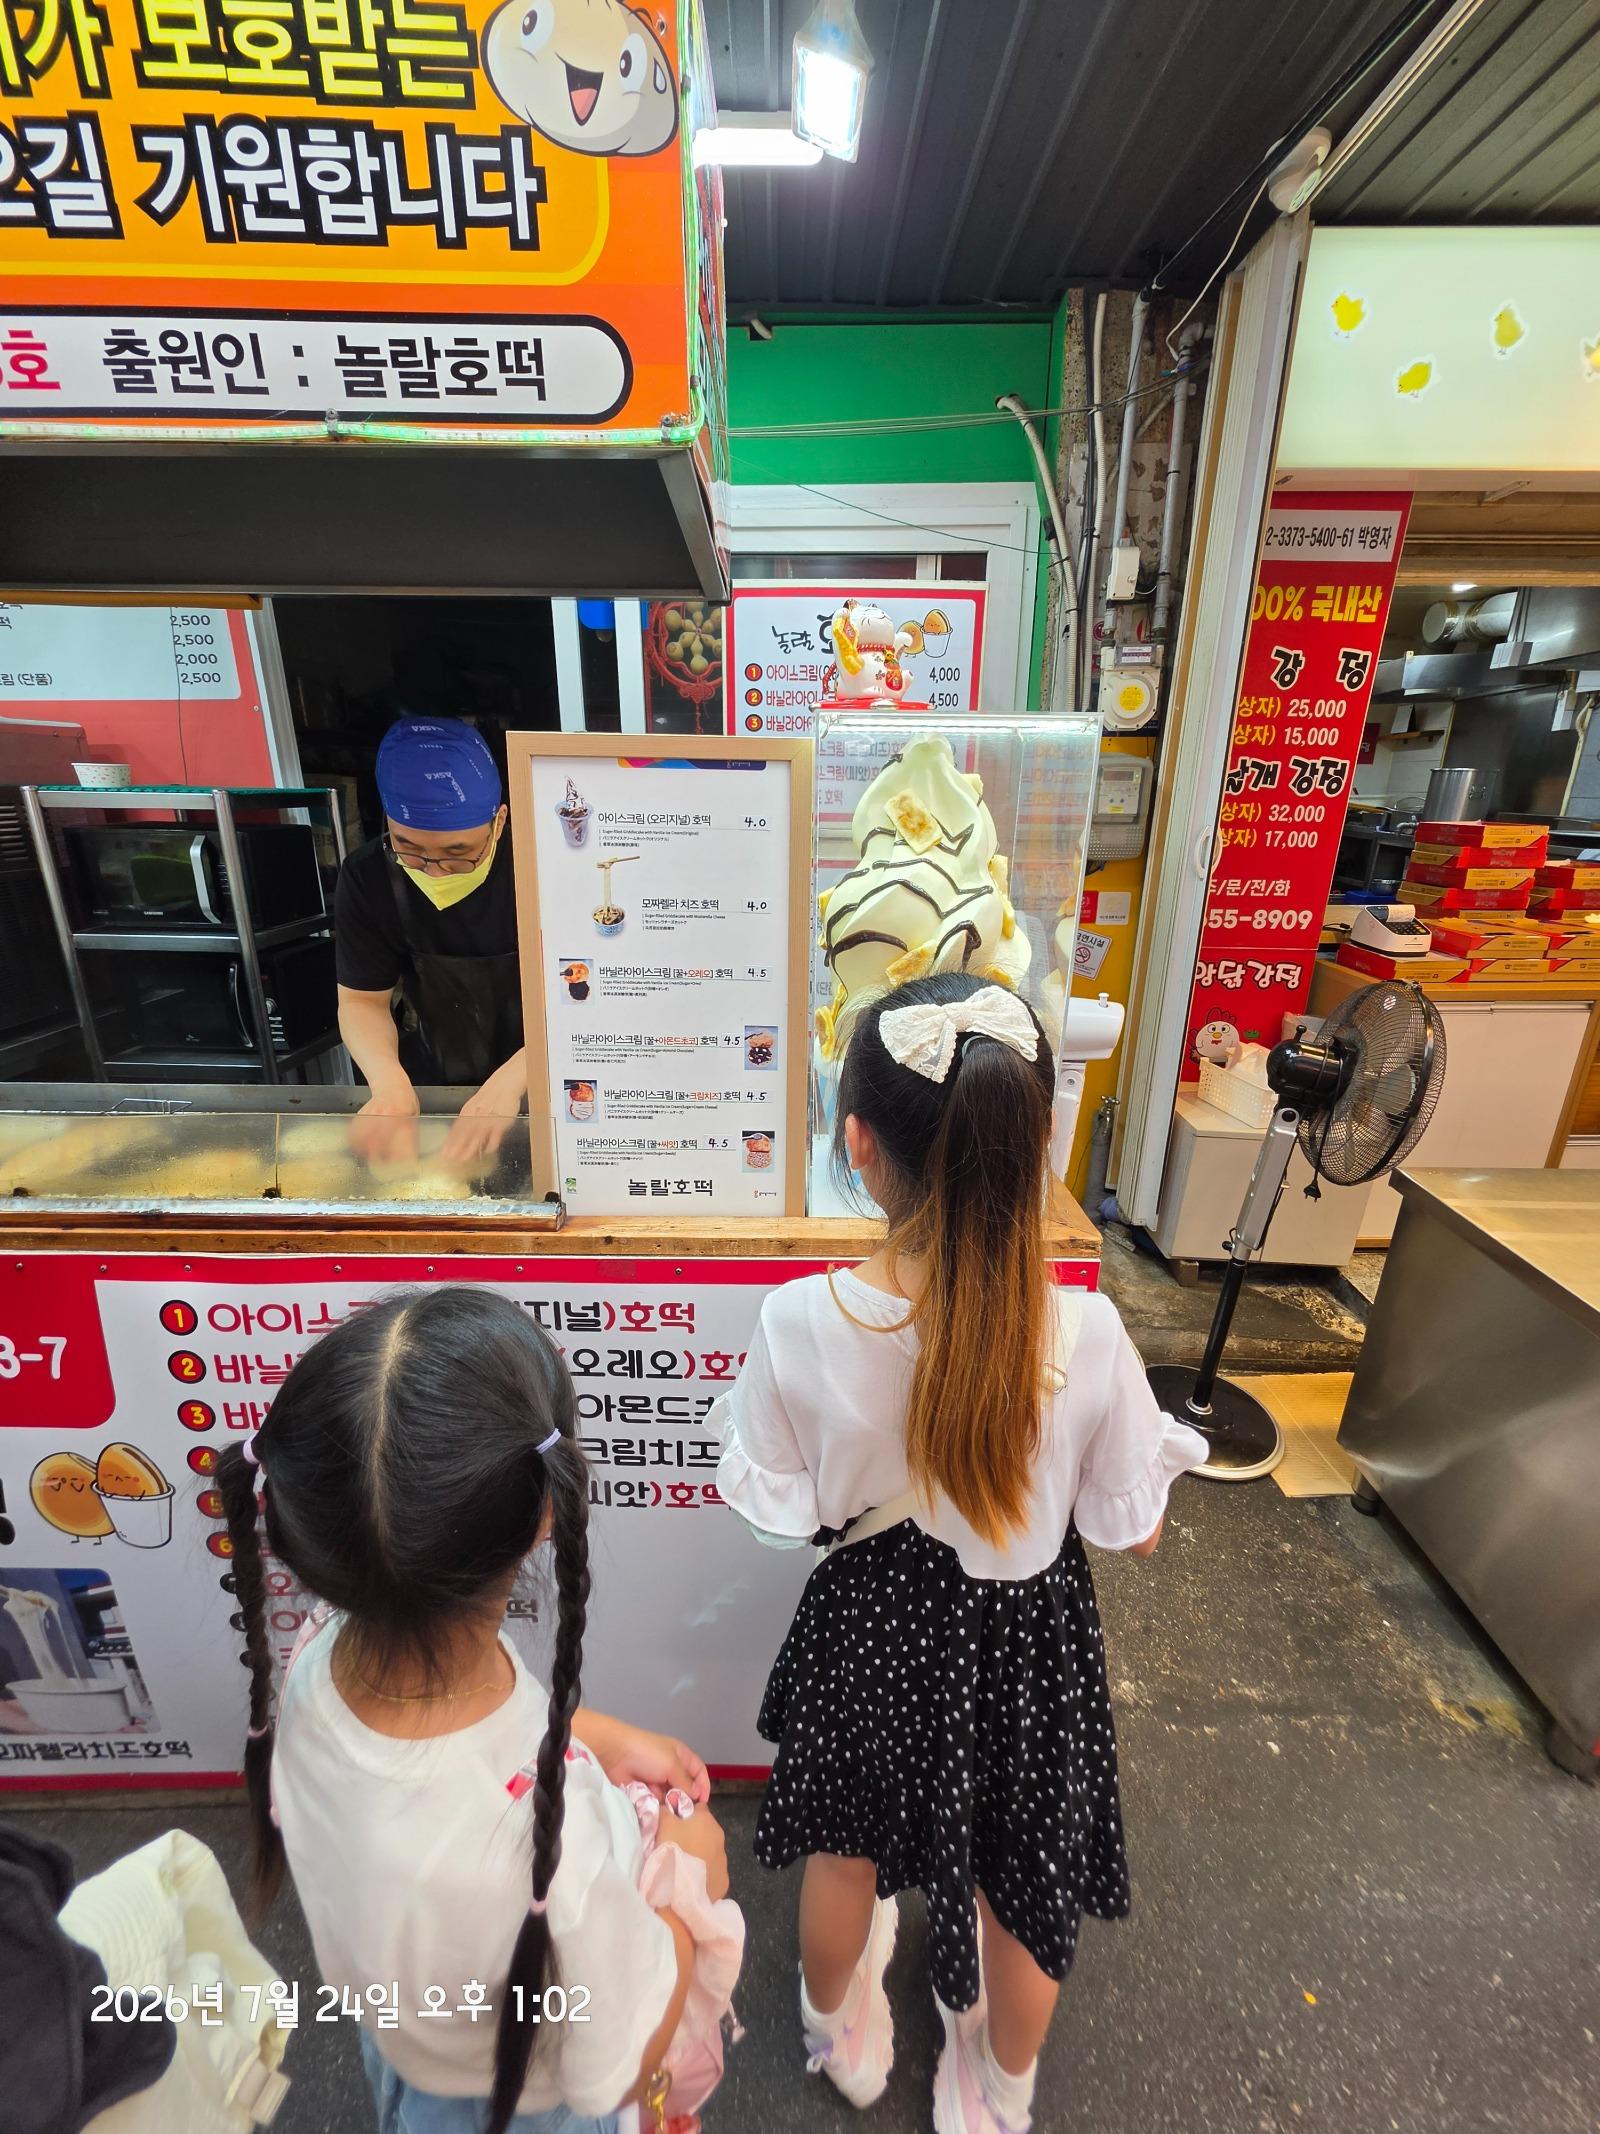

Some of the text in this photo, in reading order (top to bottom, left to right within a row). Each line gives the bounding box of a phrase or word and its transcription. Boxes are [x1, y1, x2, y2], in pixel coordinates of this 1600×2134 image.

[0, 0, 101, 88] 가
[143, 124, 536, 240] 기원합니다
[0, 328, 547, 401] 호 출원인 : 놀랄호떡
[1265, 526, 1392, 550] 2-3373-5400-61 박영자
[1311, 585, 1382, 623] 국내산
[170, 615, 211, 628] 2,500
[173, 634, 214, 647] 2,500
[175, 653, 218, 667] 2,000
[1271, 645, 1372, 692] 강 정
[0, 672, 222, 686] 림 (단품) 2,500
[929, 667, 960, 684] 4,000
[929, 692, 959, 708] 4,500
[1287, 699, 1347, 719] 25,000
[1284, 727, 1340, 747] 15,000
[1289, 755, 1350, 798] 강정
[597, 812, 767, 828] 아이스크림 (오리지널) 호떡 4.0
[1269, 804, 1326, 824] 32,000
[1265, 830, 1319, 850] 17,000
[681, 899, 699, 910] 치즈
[701, 899, 719, 910] 호떡
[747, 901, 767, 912] 4.0
[1203, 908, 1313, 930] 55-8909
[599, 966, 671, 979] 바닐라아이스크림
[715, 968, 733, 979] 호떡
[747, 967, 767, 978] 4.5
[571, 1034, 643, 1046] 바닐라아이스크림
[700, 1035, 718, 1046] 호떡
[723, 1035, 741, 1046] 4.5
[604, 1089, 673, 1101] 바닐라아이스크림
[723, 1091, 741, 1101] 호떡
[746, 1091, 768, 1101] 4.5
[577, 1138, 645, 1149] 바닐라아이스크림
[680, 1139, 698, 1149] 호떡
[708, 1138, 728, 1148] 4.5
[628, 1179, 713, 1197] 놀랄호떡
[516, 1301, 695, 1334] 지널)호떡
[213, 1353, 305, 1385] 바닐
[558, 1348, 748, 1380] 오레오)호
